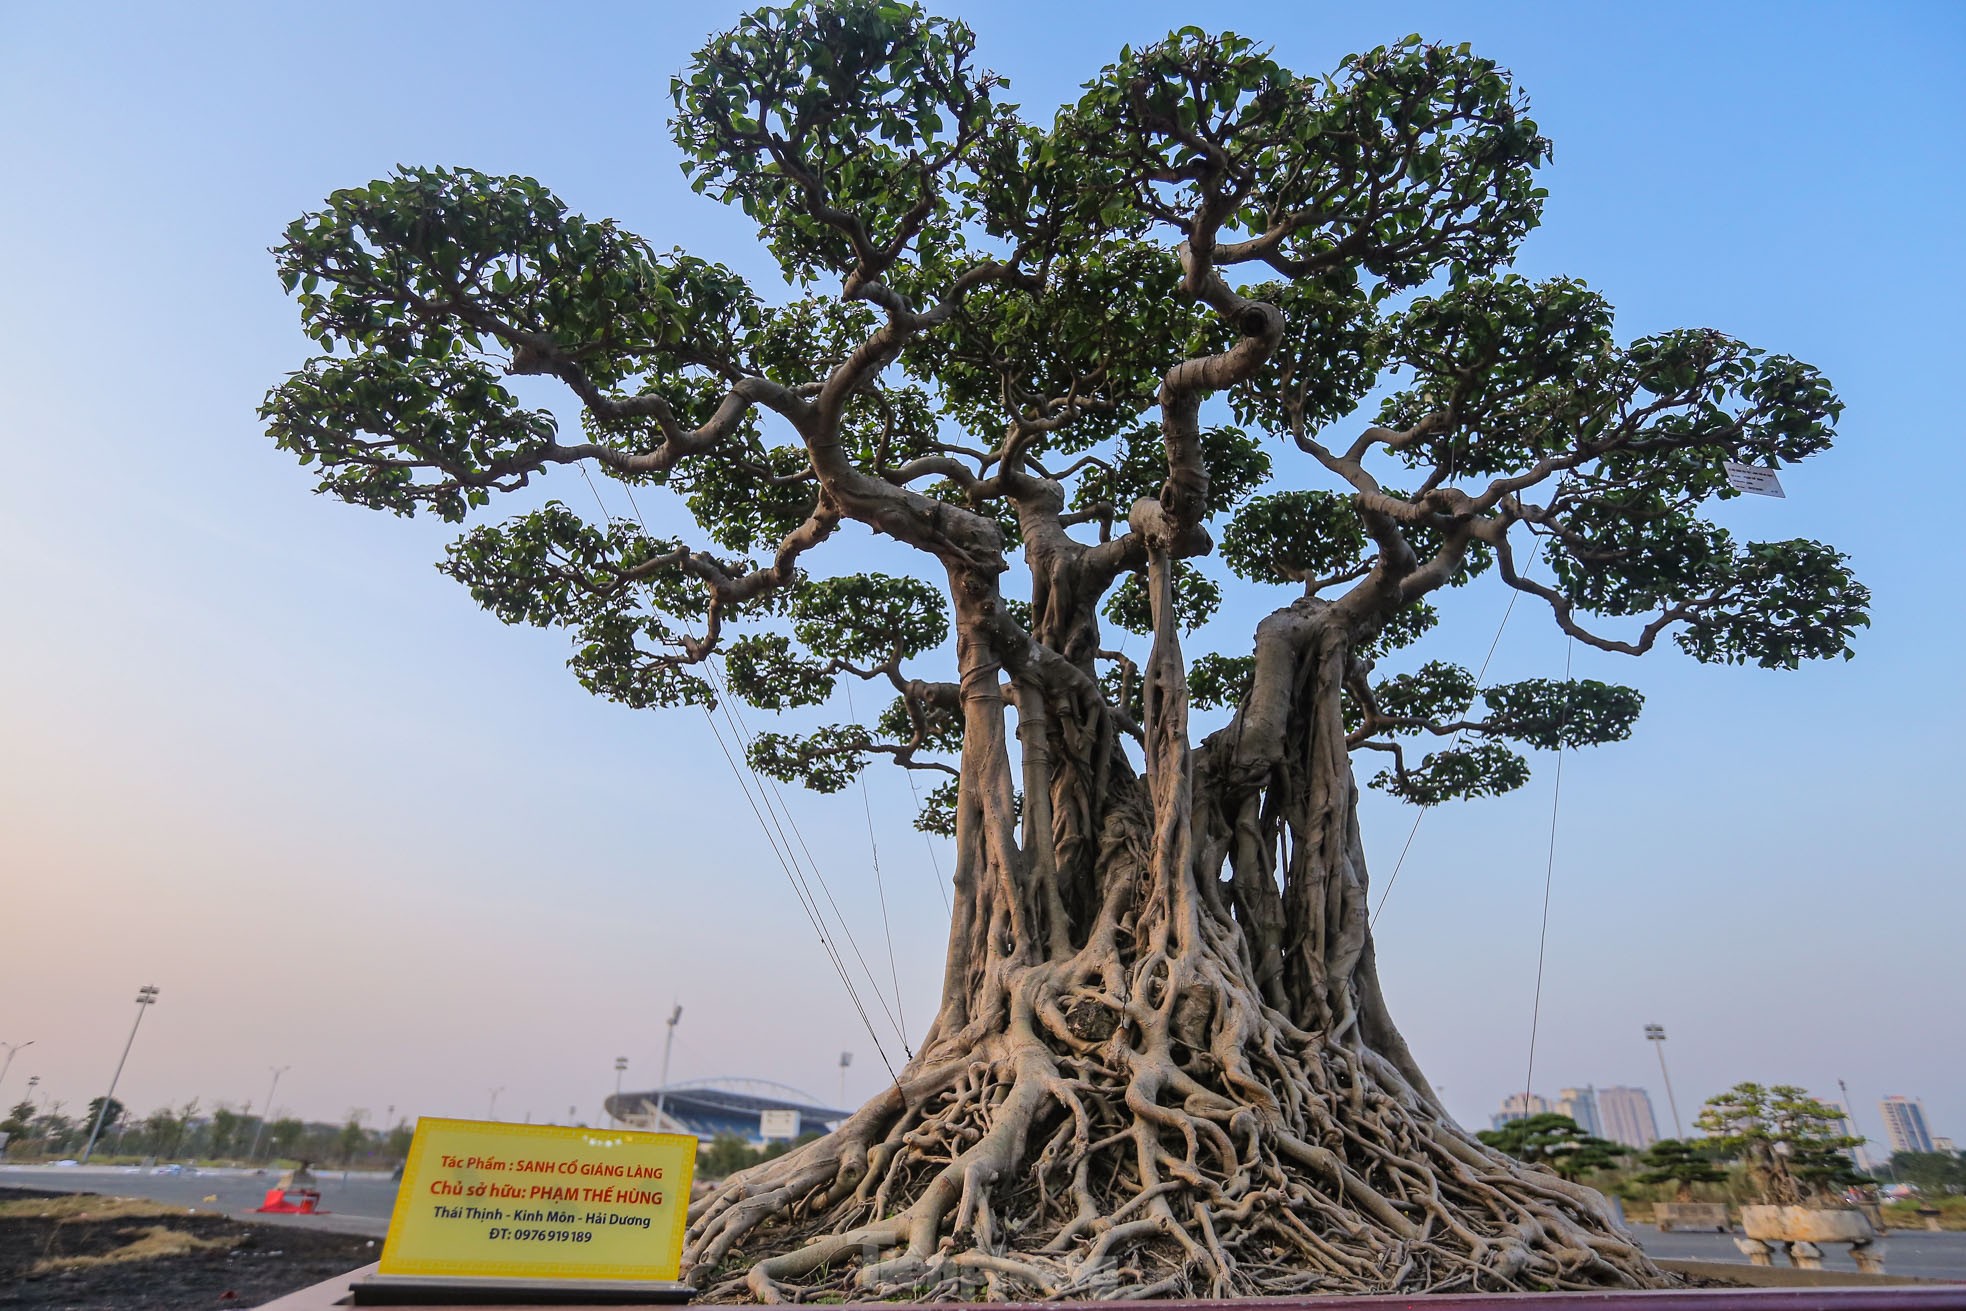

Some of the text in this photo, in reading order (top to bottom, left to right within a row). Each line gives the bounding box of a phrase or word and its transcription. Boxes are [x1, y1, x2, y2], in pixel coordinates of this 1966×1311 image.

[441, 1155, 465, 1169] Tác
[516, 1160, 556, 1174] SANH
[580, 1162, 624, 1178] GIÁNG
[626, 1164, 663, 1179] LÀNG
[430, 1180, 663, 1205] Chủ sở hữu: PHẠM THẾ HÙNG
[434, 1206, 463, 1219] Thái
[466, 1207, 503, 1223] Thịnh
[514, 1209, 544, 1222] Kinh
[546, 1211, 575, 1223] Môn
[585, 1212, 607, 1225] Hải
[609, 1213, 651, 1229] Dương
[489, 1227, 512, 1240] ĐT:
